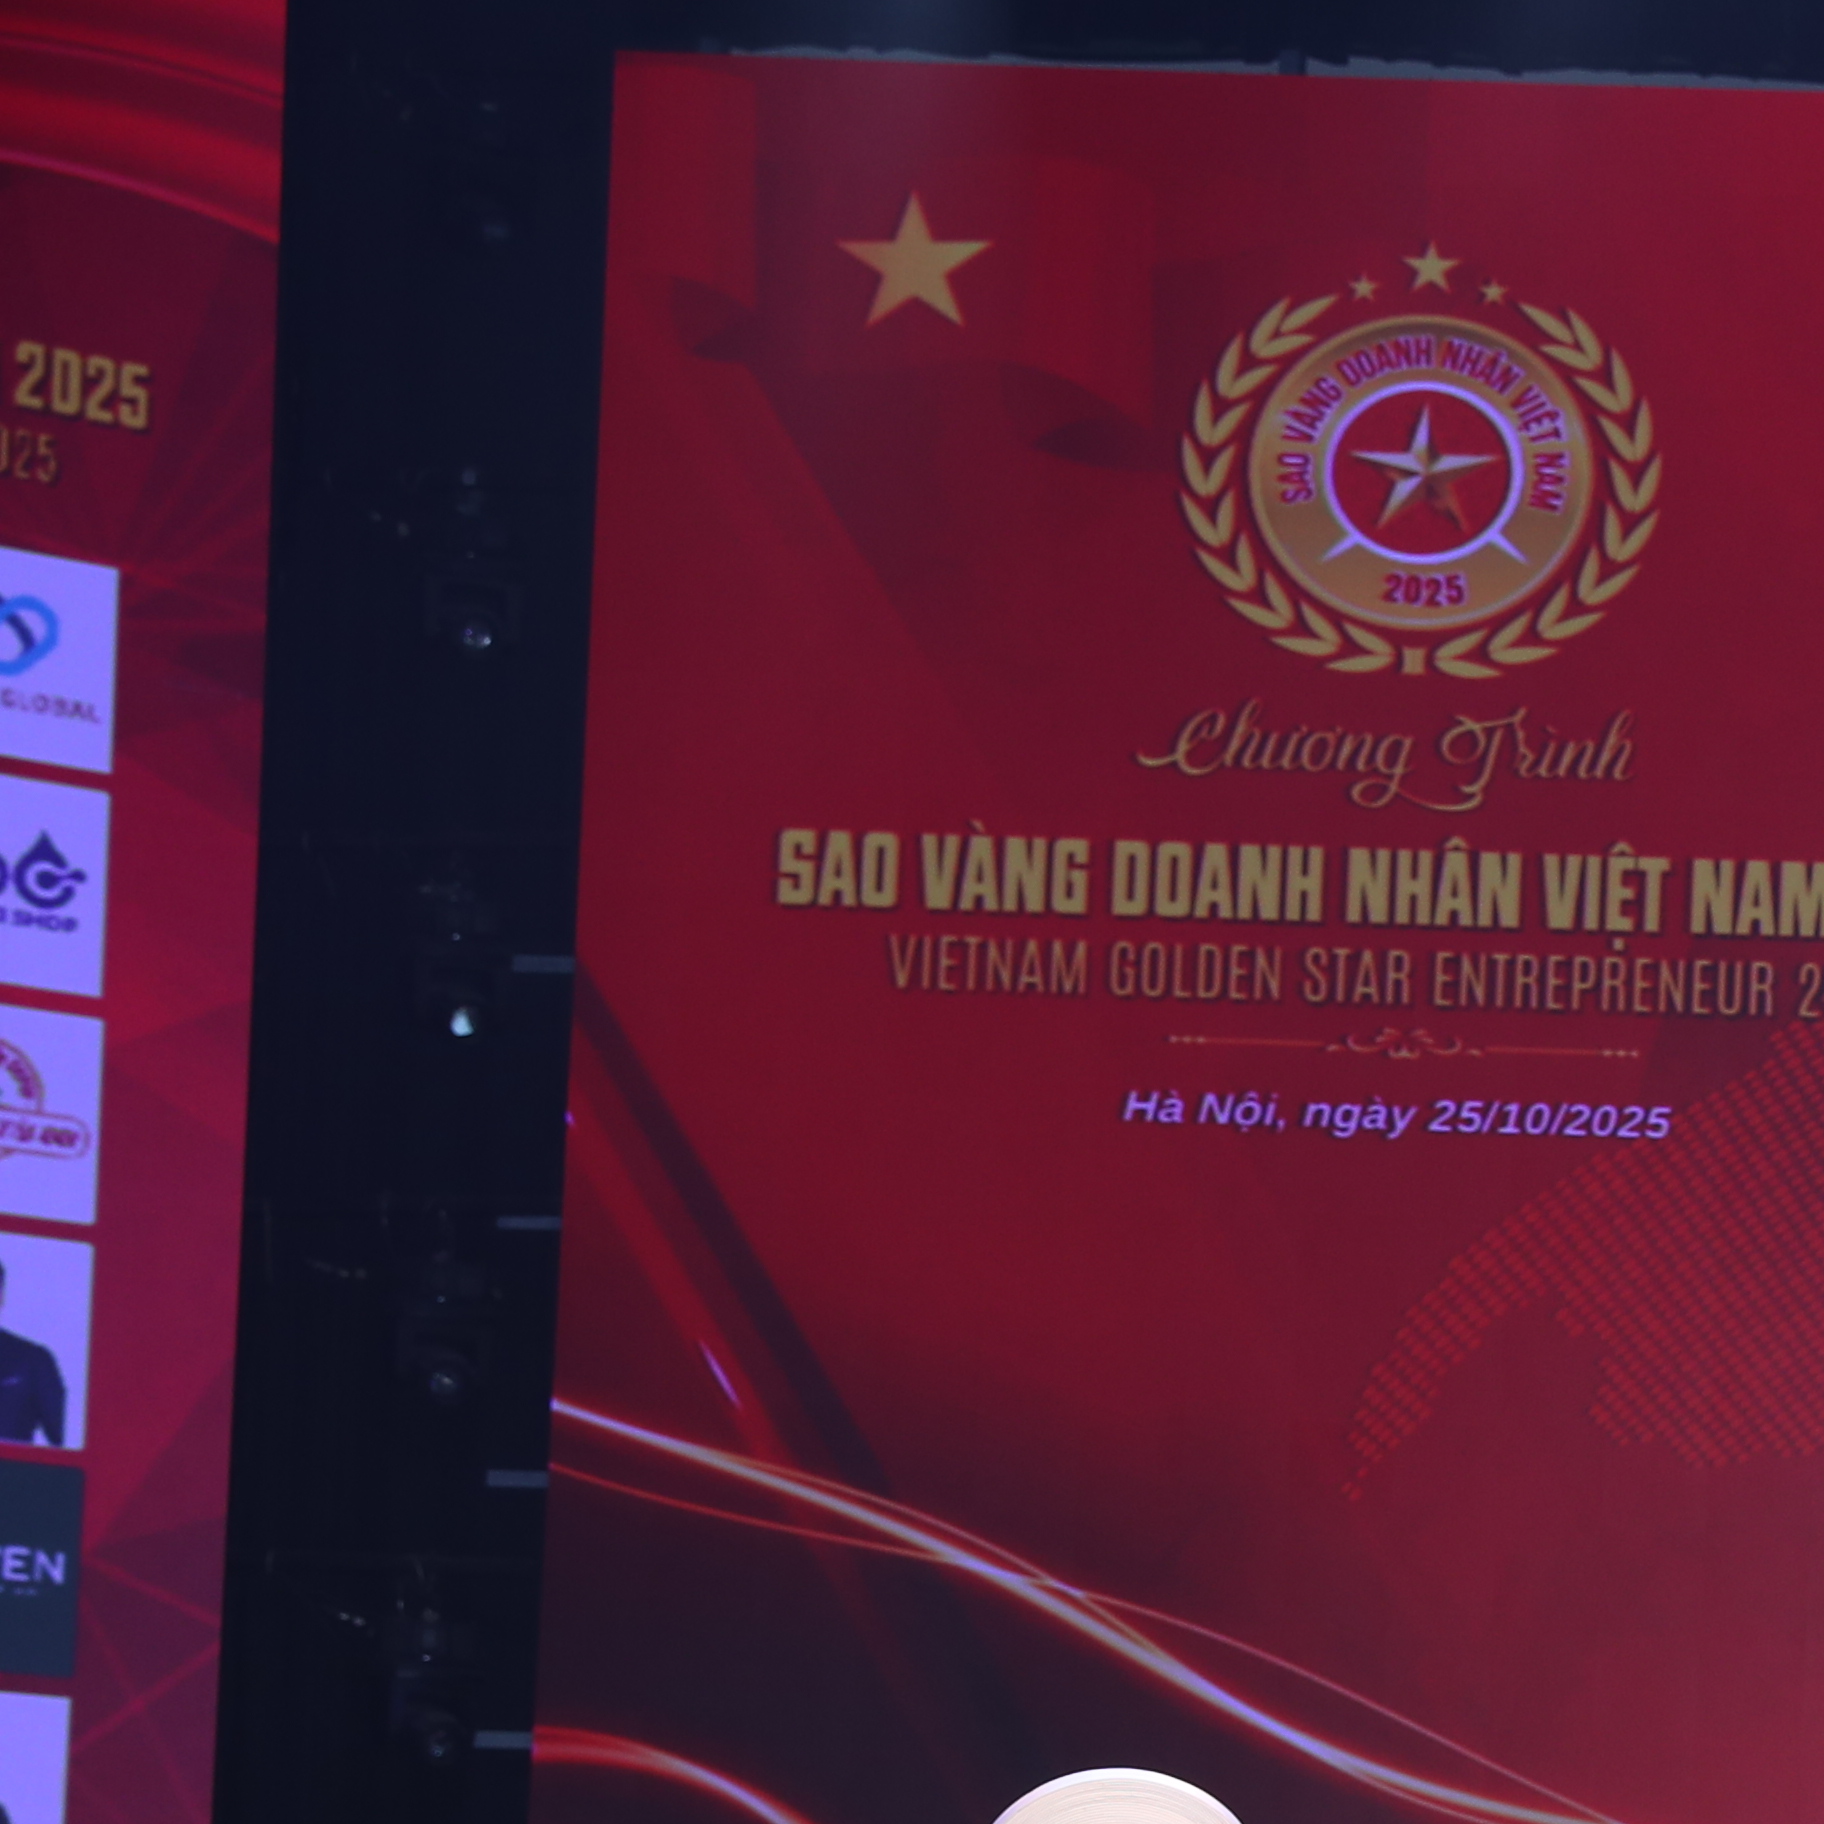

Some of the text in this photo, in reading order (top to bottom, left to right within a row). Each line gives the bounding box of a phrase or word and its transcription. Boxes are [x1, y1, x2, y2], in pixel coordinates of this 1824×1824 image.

[14, 340, 150, 431] 2025
[1336, 336, 1435, 388] DOANH
[1442, 337, 1523, 396] NHÂN
[1512, 385, 1566, 445] VIỆT
[1280, 456, 1315, 505] SAO
[1530, 451, 1568, 514] NAM
[1383, 573, 1465, 605] 2025
[1137, 699, 1635, 808] Chương Trình
[776, 826, 898, 907] SAO
[920, 819, 1090, 915] VÀNG
[1111, 836, 1323, 922] DOANH
[1344, 835, 1522, 930] NHÂN
[1543, 837, 1670, 951] VIỆT
[888, 932, 1088, 995] VIETNAM
[1110, 940, 1281, 1000] GOLDEN
[1303, 945, 1411, 1004] STAR
[1433, 952, 1774, 1018] ENTREPRENEUR
[1122, 1090, 1671, 1140] Hà Nội, ngày 25/10/2025
[0, 1546, 66, 1585] EN
